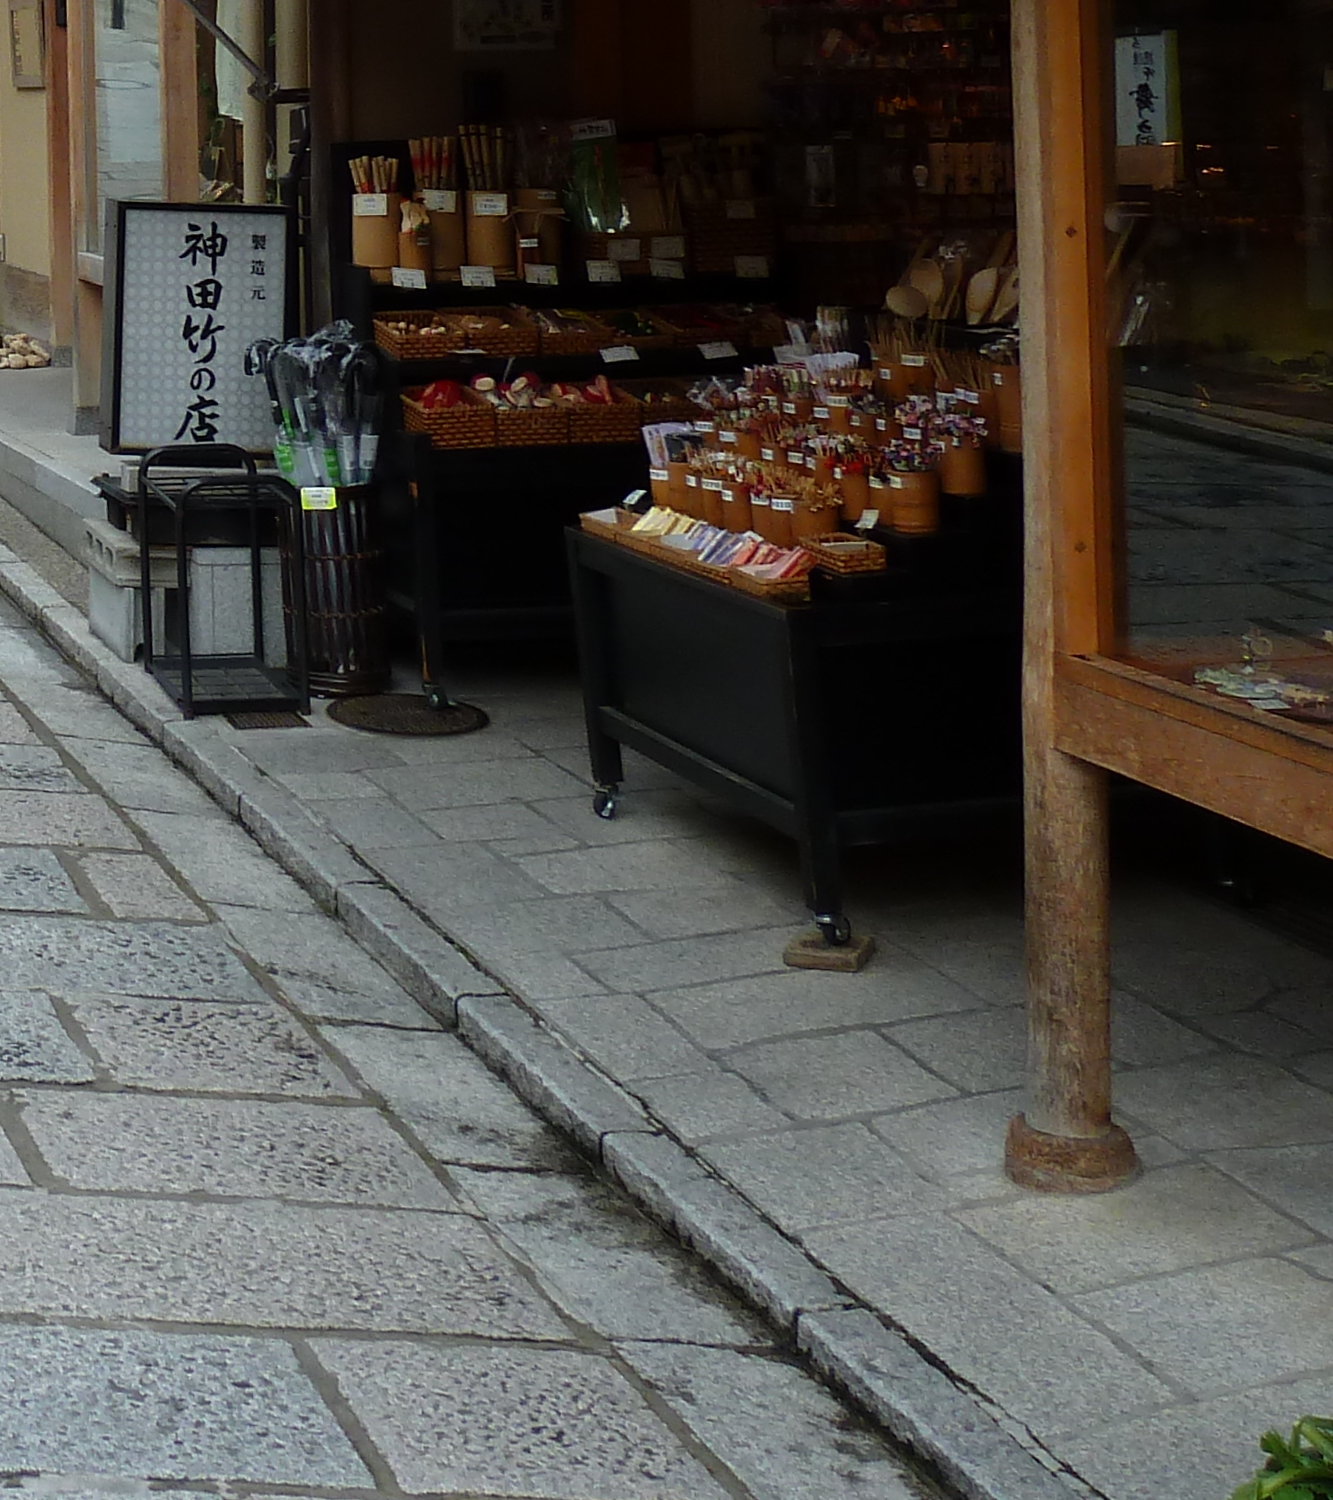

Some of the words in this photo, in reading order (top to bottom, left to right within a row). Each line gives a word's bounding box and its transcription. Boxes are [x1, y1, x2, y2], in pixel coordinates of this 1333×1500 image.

[174, 220, 229, 443] 神田竹の店
[250, 234, 267, 302] 製造元
